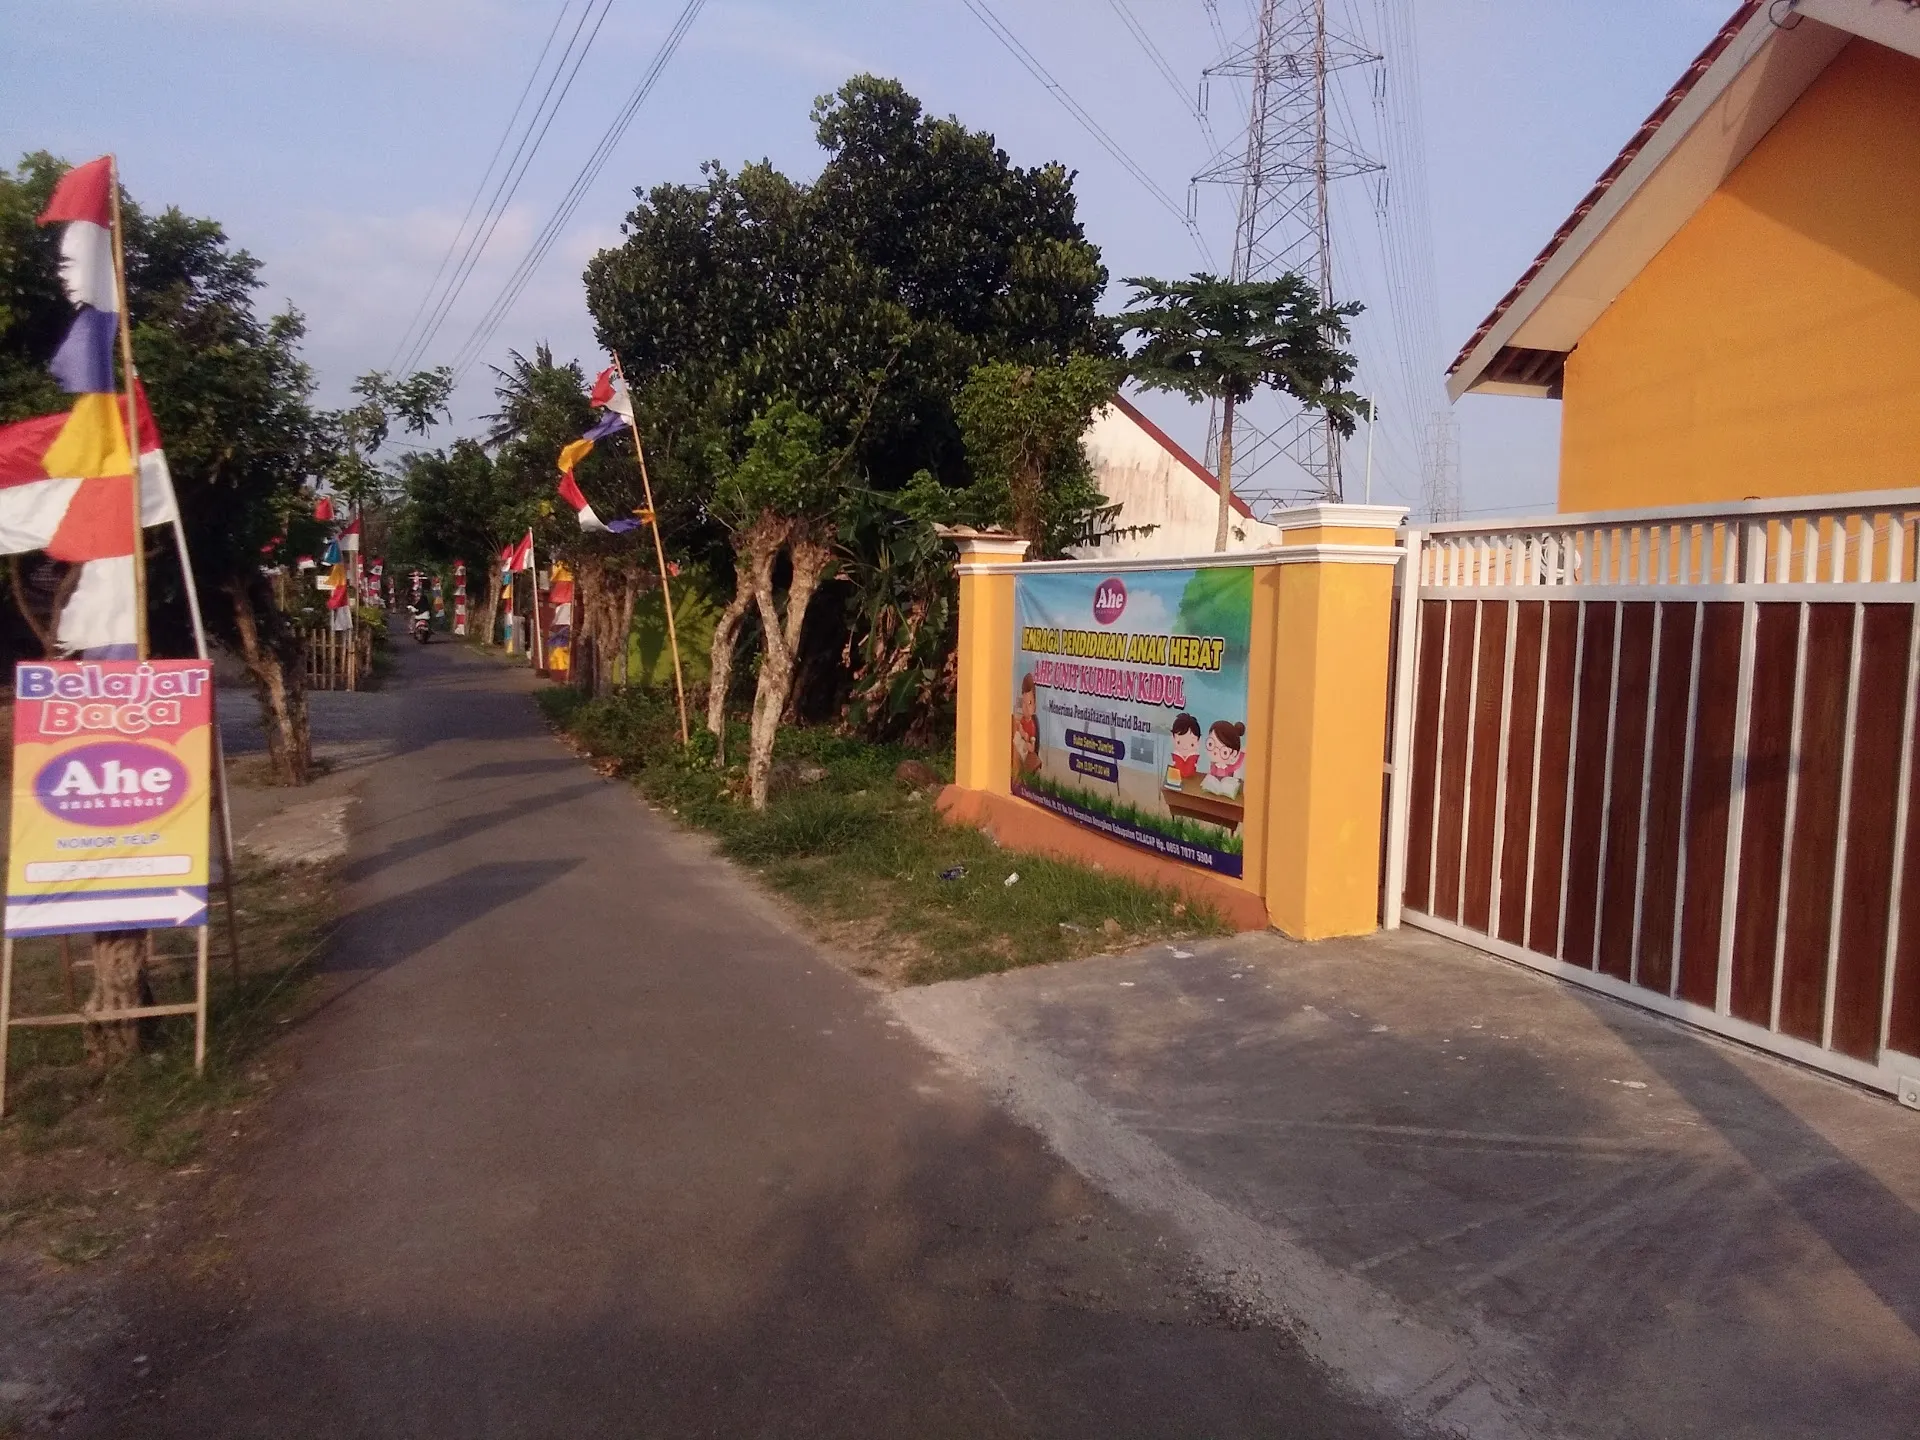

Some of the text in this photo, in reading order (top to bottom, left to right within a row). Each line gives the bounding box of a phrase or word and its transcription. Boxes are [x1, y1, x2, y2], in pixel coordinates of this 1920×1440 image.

[1096, 587, 1124, 609] Ahe
[1060, 629, 1128, 661] PENDIDIKAN
[1127, 633, 1168, 665] ANAK
[1168, 636, 1224, 672] HEBAT
[16, 664, 210, 705] Belajar
[1053, 662, 1079, 692] UNIT
[1079, 665, 1138, 702] KURIPAN
[1138, 671, 1186, 710] KIDUL
[39, 699, 181, 735] Baca
[1048, 700, 1152, 733] Menerima Pendaftaran Murid Baru
[51, 760, 173, 796] Ahe
[59, 796, 164, 810] anak hebat
[56, 832, 161, 850] NOMOR TELP
[1135, 830, 1156, 847] CILACAP
